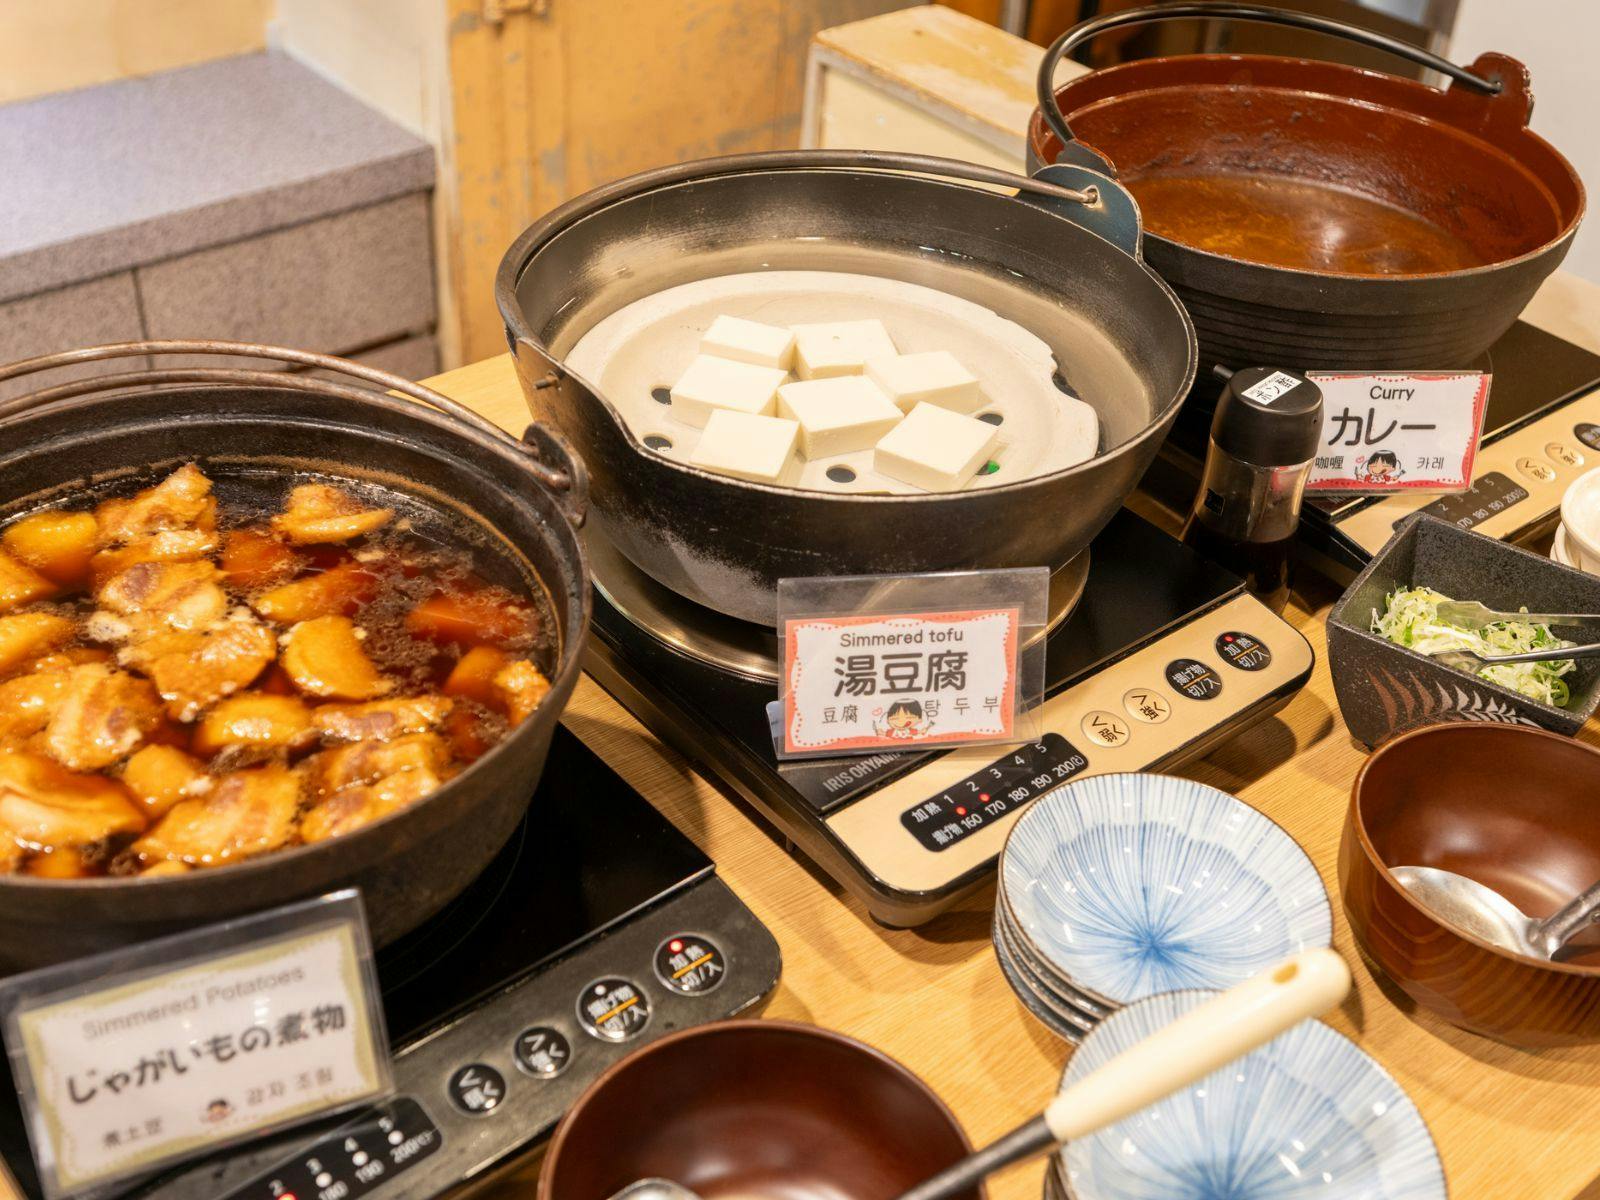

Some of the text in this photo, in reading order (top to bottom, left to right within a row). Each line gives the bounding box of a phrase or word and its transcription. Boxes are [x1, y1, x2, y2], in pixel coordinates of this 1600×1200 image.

[1370, 385, 1415, 401] Curry
[1328, 407, 1436, 446] カレー
[1416, 457, 1444, 470] 카레
[1439, 503, 1448, 511] 2
[1485, 478, 1494, 486] 5
[1473, 508, 1489, 519] 180
[1488, 500, 1504, 511] 190
[840, 627, 963, 648] Simmered tofu
[834, 649, 968, 697] 湯豆腐
[1172, 664, 1206, 685] 揚げ物
[821, 704, 858, 724] 豆腐
[925, 696, 999, 717] 탕 두 부
[822, 771, 854, 792] IRIS
[911, 743, 1047, 823] 加熱 1 2 3 4 5
[961, 813, 983, 830] 160
[985, 800, 1007, 816] 170
[1008, 787, 1030, 803] 180
[1031, 774, 1053, 789] 190
[82, 967, 305, 1039] Simmered Potatoes
[66, 1005, 346, 1105] じゃがいもの煮物
